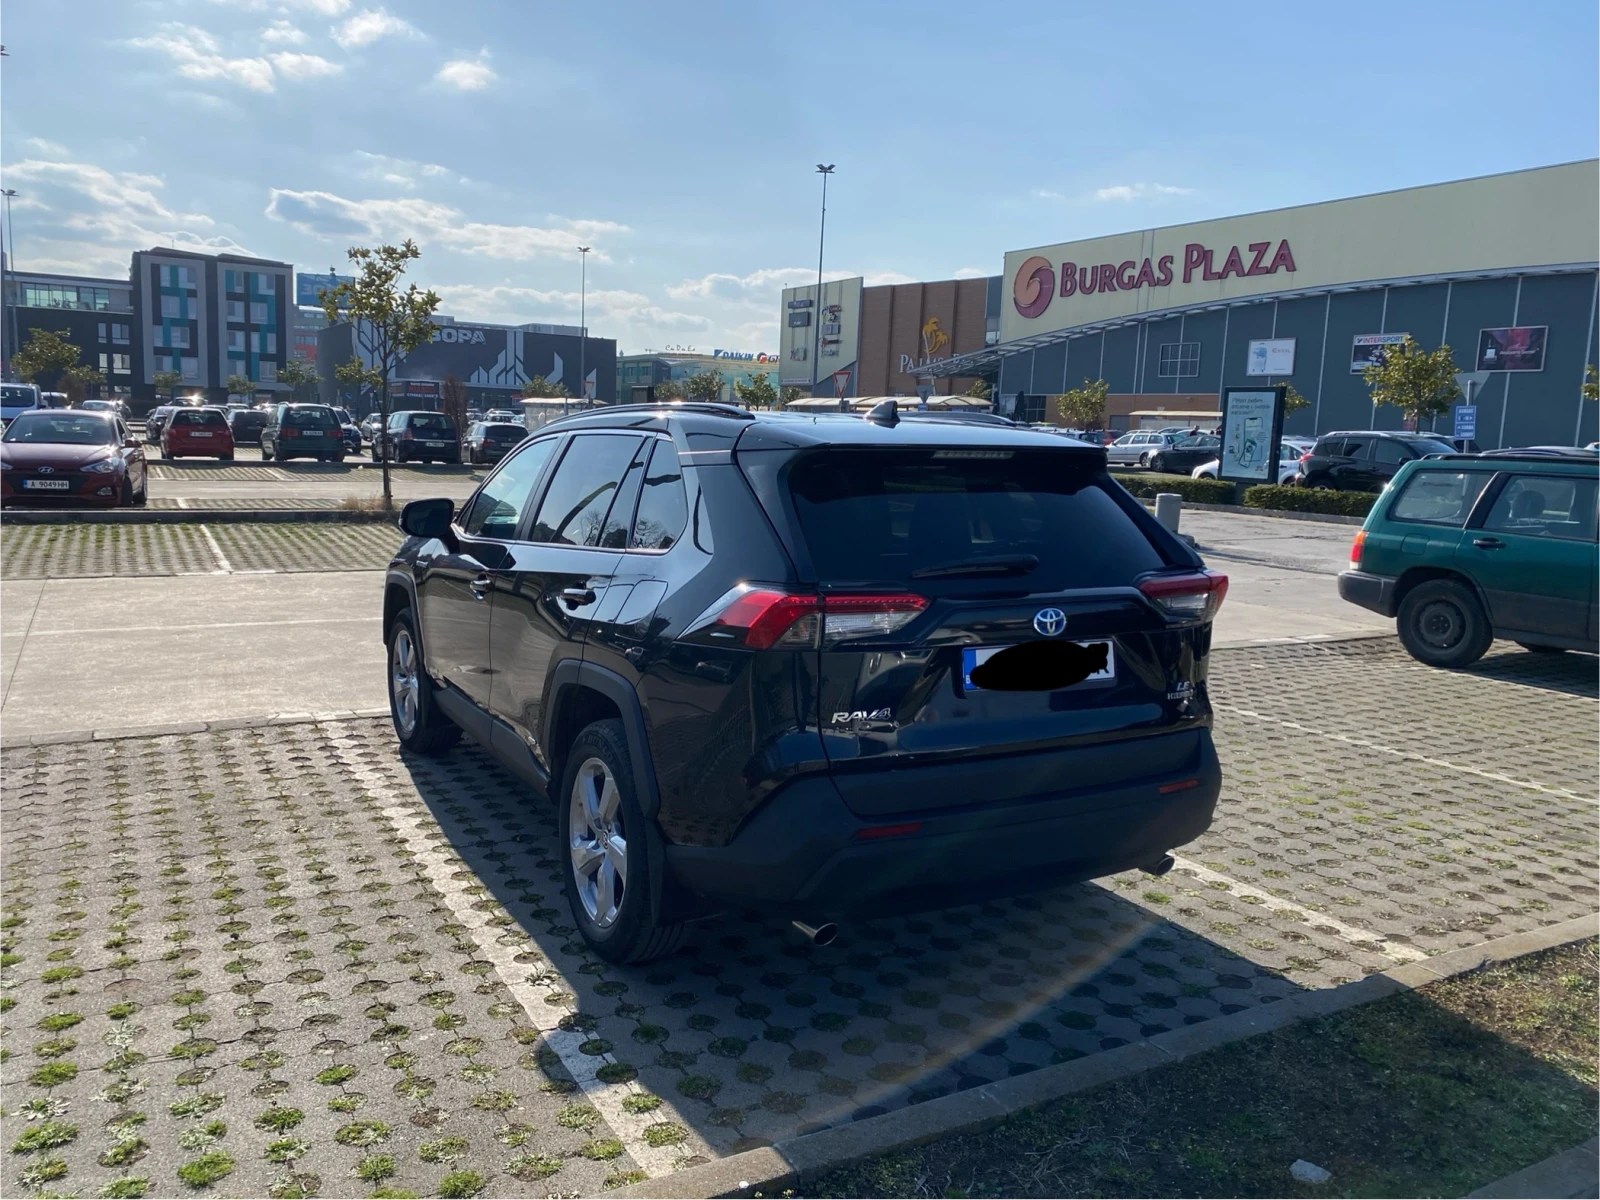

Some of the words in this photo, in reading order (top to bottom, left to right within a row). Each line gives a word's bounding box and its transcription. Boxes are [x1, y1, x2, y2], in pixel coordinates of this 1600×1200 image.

[1060, 254, 1173, 298] BURGAS
[1182, 239, 1297, 284] PLAZA
[1363, 335, 1404, 343] INTERSPORT
[722, 351, 754, 361] DAIKIN
[831, 707, 892, 724] RAV4
